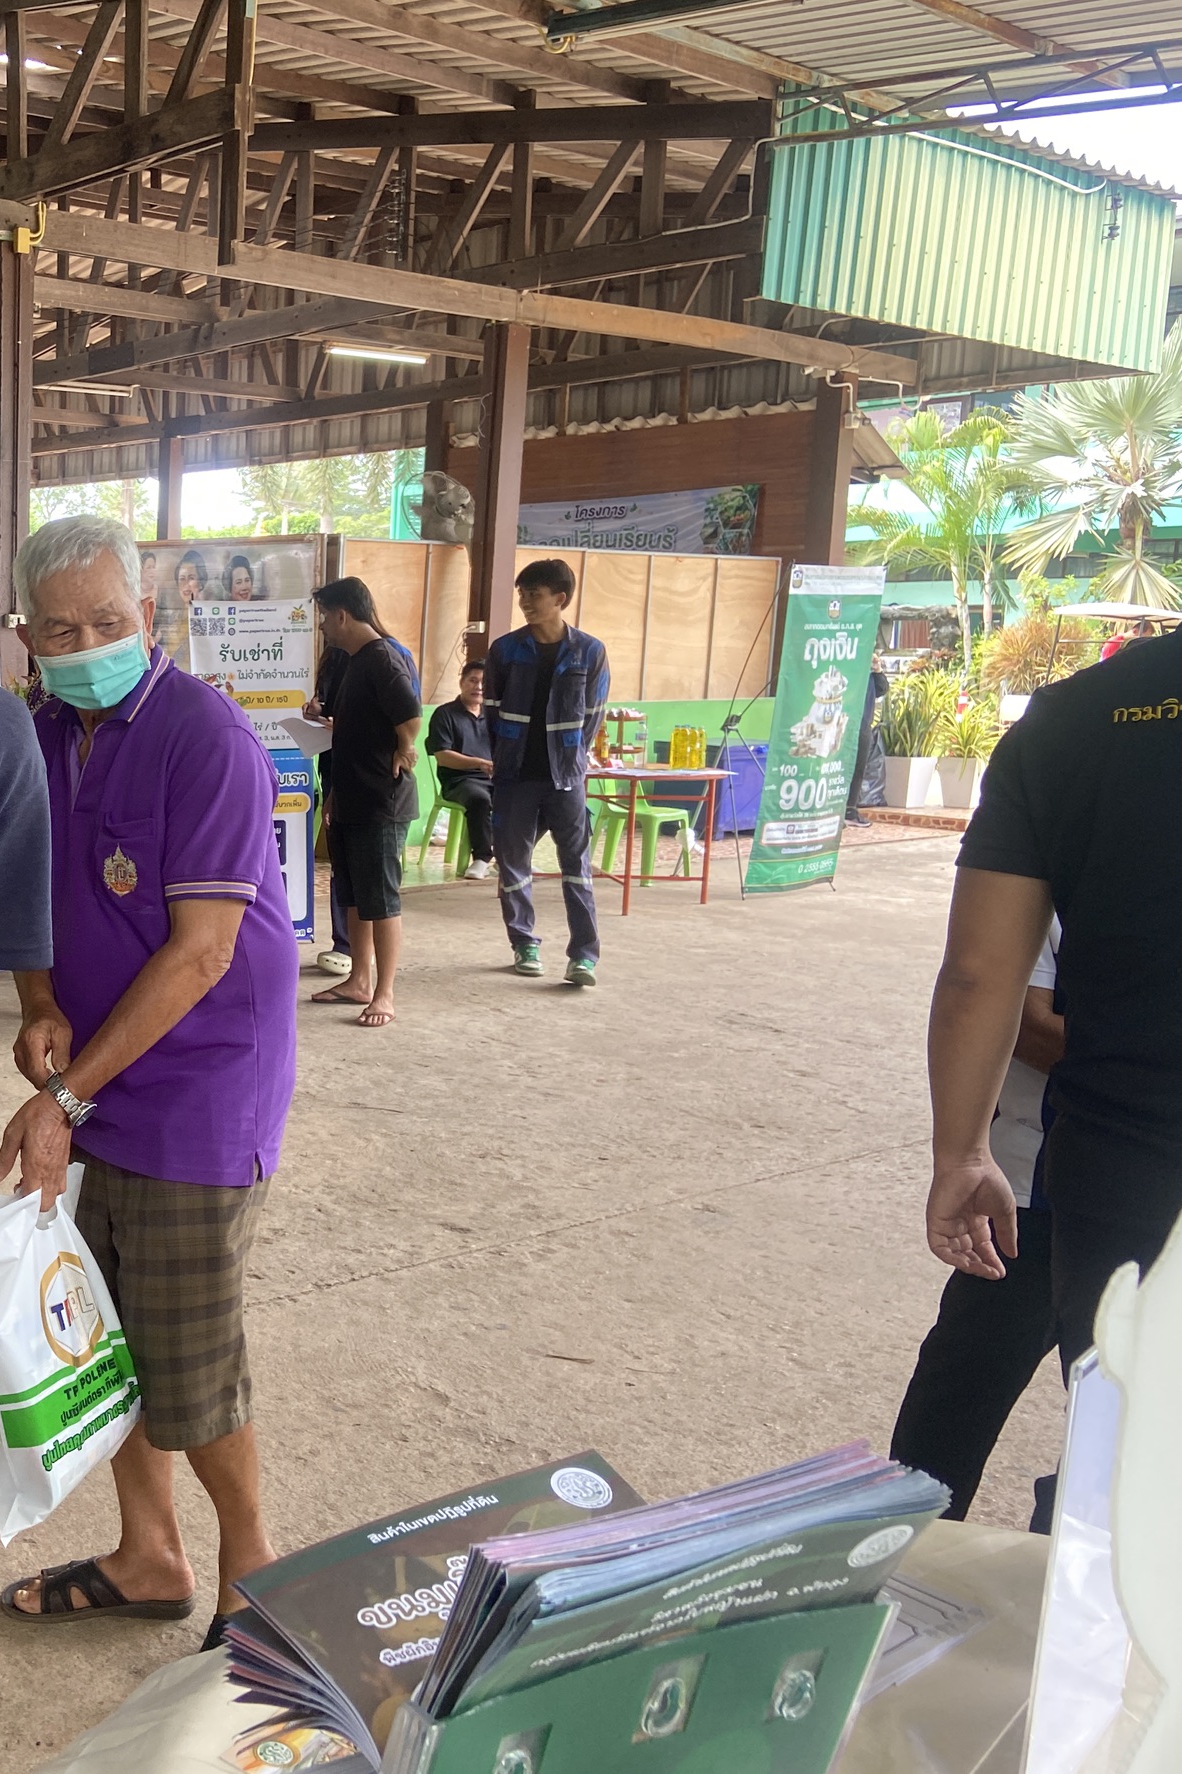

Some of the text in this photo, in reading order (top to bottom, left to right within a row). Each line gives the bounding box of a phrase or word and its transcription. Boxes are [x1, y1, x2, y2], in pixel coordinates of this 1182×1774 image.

[574, 505, 625, 521] โครงการ
[219, 636, 283, 662] รับเช่าที่
[237, 668, 311, 680] ไม่จำกัดจำนวนไร่
[1113, 697, 1182, 723] กรมวิ
[277, 772, 309, 786] บเรา
[779, 764, 798, 776] 100
[779, 777, 827, 810] 900
[368, 1494, 499, 1544] สินค้าในเขตปฏิรูปที่ดิน
[380, 1638, 441, 1666] พืชผักอิ
